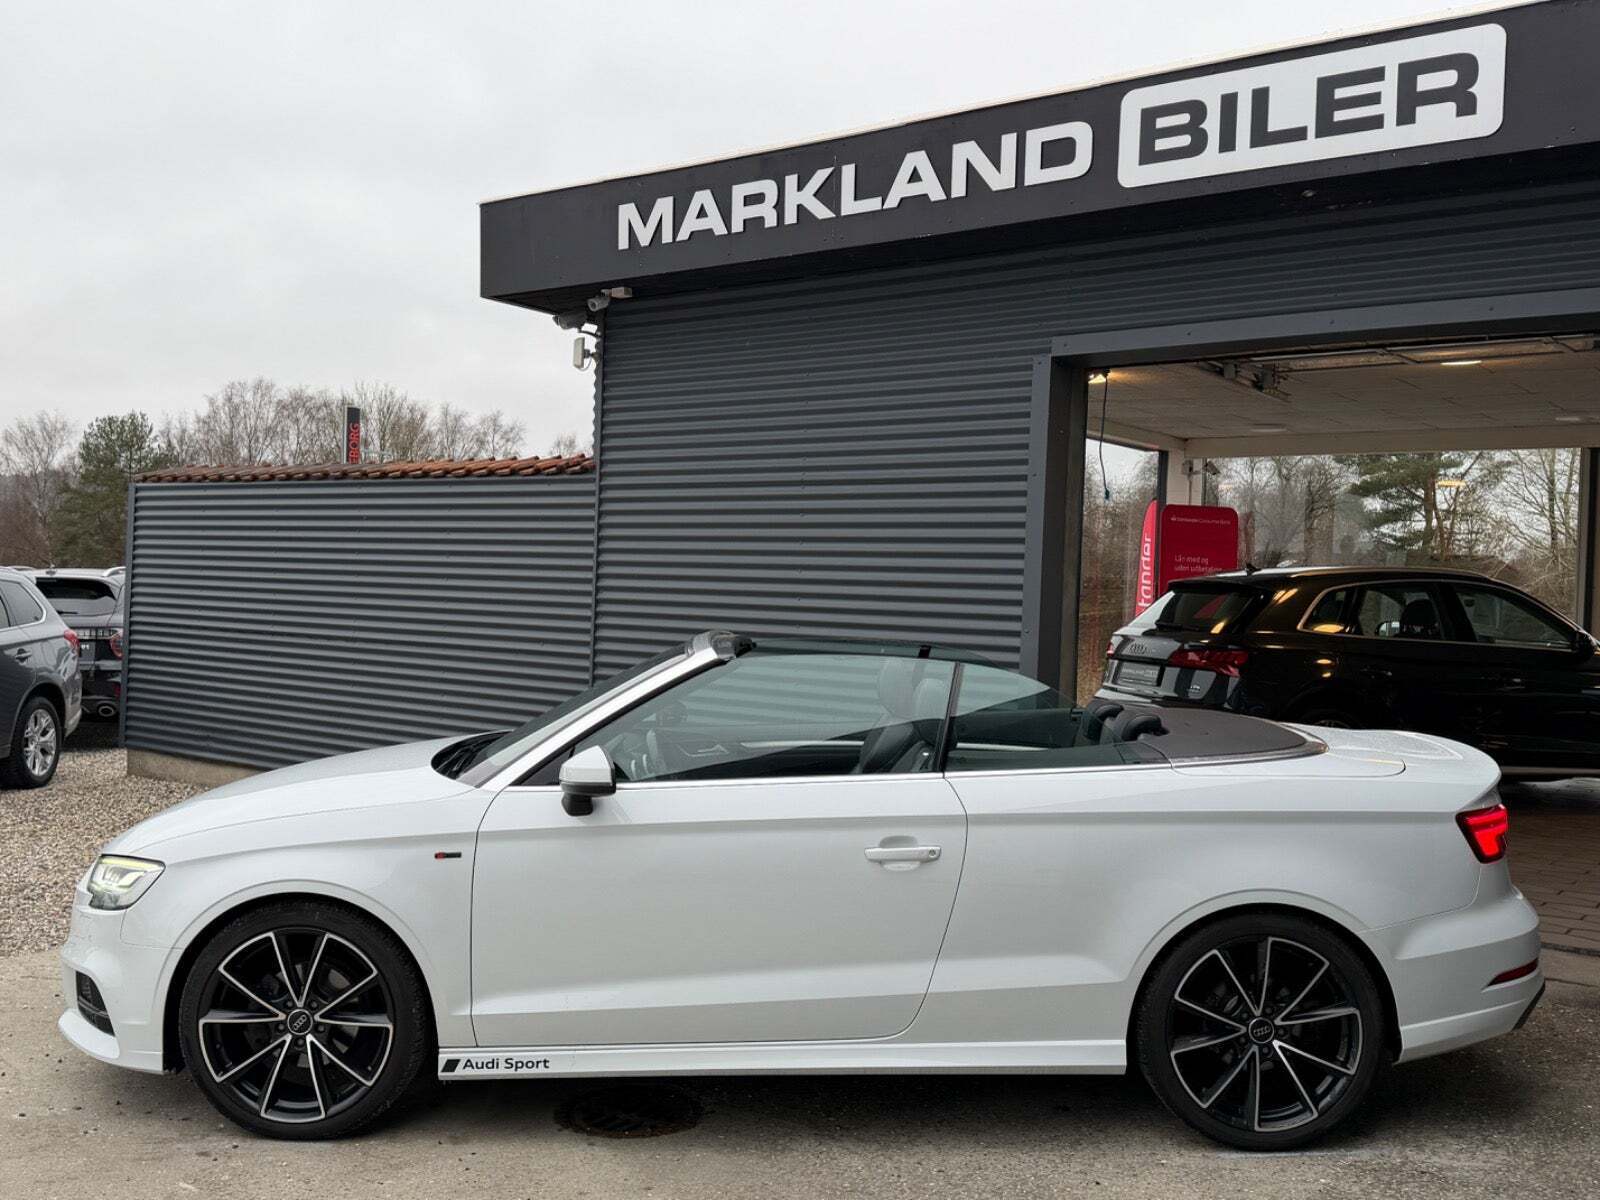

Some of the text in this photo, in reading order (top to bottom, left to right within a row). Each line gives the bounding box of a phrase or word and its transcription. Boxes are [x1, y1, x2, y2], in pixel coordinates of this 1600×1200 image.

[617, 51, 1480, 251] MARKLAND BILER
[462, 1058, 550, 1072] Audi Sport
